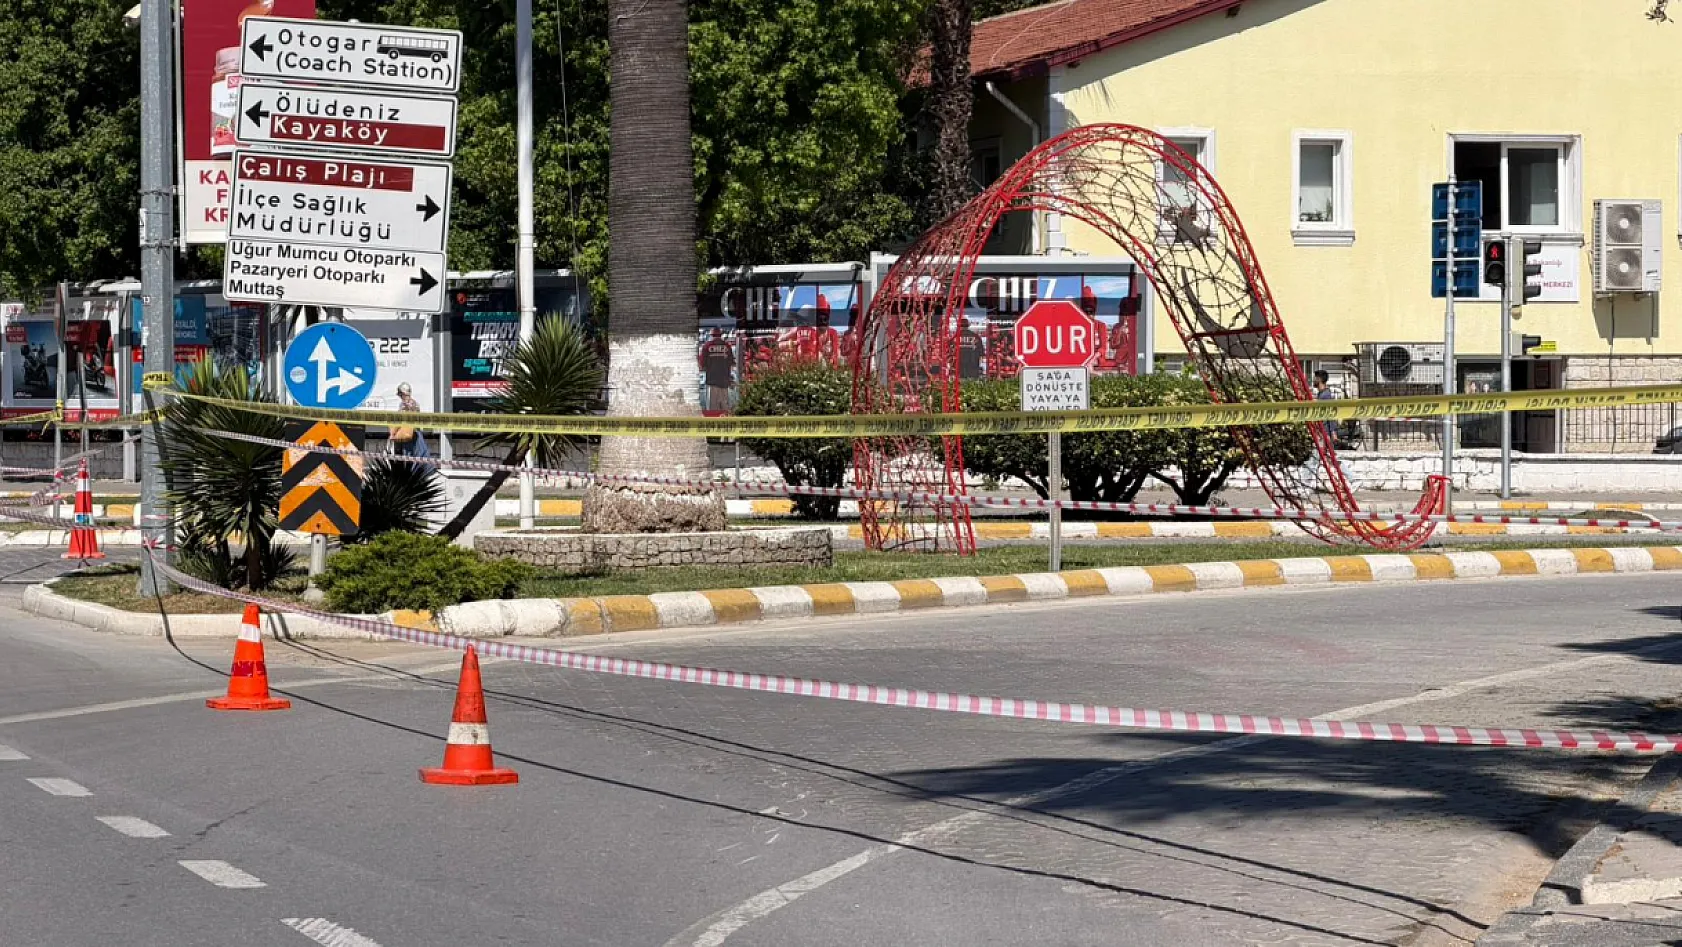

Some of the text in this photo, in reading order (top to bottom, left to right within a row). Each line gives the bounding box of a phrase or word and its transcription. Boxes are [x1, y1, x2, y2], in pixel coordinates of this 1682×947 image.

[278, 29, 371, 53] Otogar
[276, 51, 452, 86] (Coach Station)
[276, 91, 400, 121] Ölüdeniz
[273, 116, 388, 145] Kayaköy
[241, 158, 385, 188] Çalış Plajı
[238, 184, 367, 216] İlçe Sağlık
[236, 212, 392, 243] Müdürlüğü
[231, 243, 416, 267] Uğur Mumcu Otoparkı
[230, 261, 385, 284] Pazaryeri Otoparkı
[229, 279, 285, 298] Muttaş
[380, 337, 410, 353] 222
[1022, 325, 1087, 354] DUR
[1026, 382, 1083, 392] DÖNÜŞTE
[1037, 371, 1071, 380] SAĞA
[1030, 395, 1080, 403] YAYA'YA
